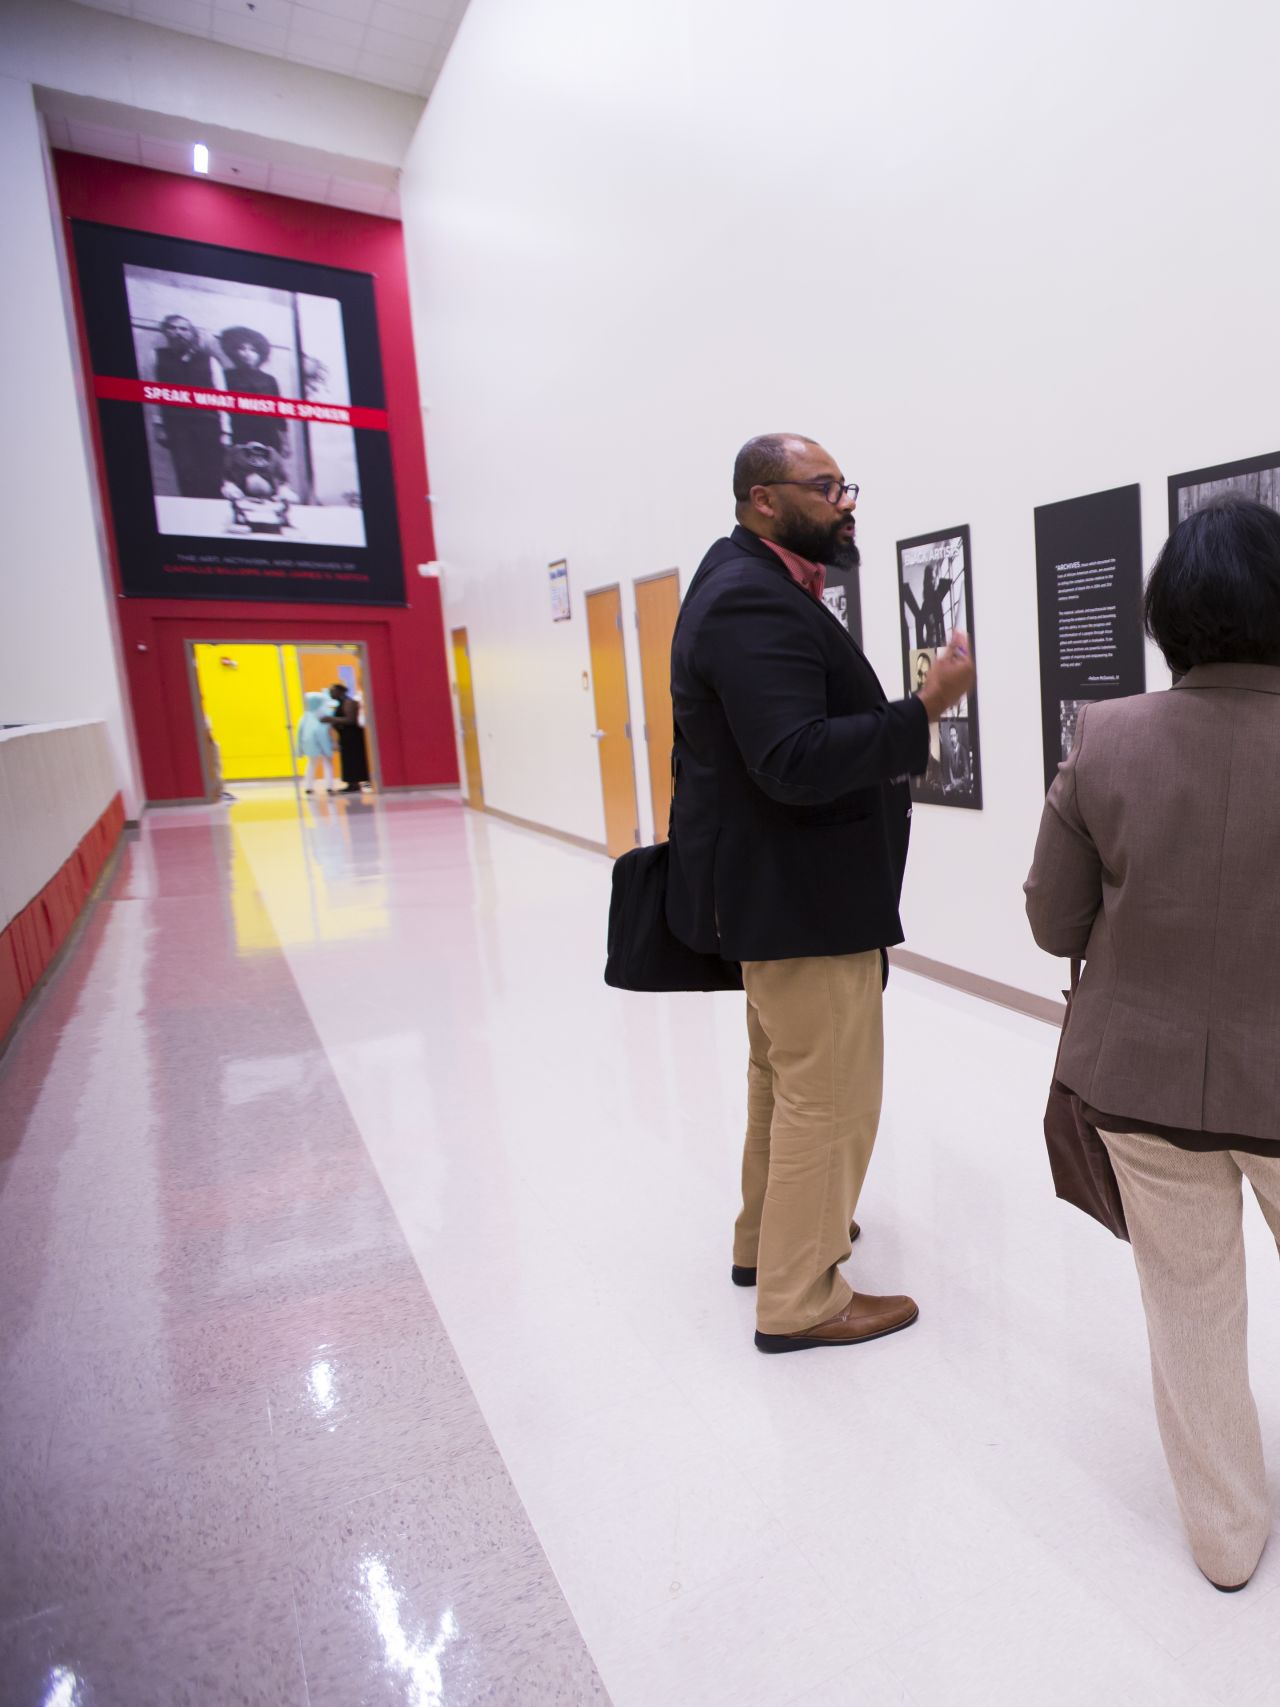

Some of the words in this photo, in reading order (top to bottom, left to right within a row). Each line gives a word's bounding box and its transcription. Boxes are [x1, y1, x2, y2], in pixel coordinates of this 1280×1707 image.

[143, 386, 192, 403] SPEAK
[193, 391, 235, 408] WHAT
[238, 396, 275, 413] MUST
[277, 401, 296, 415] BE
[297, 404, 350, 422] SPOKEN
